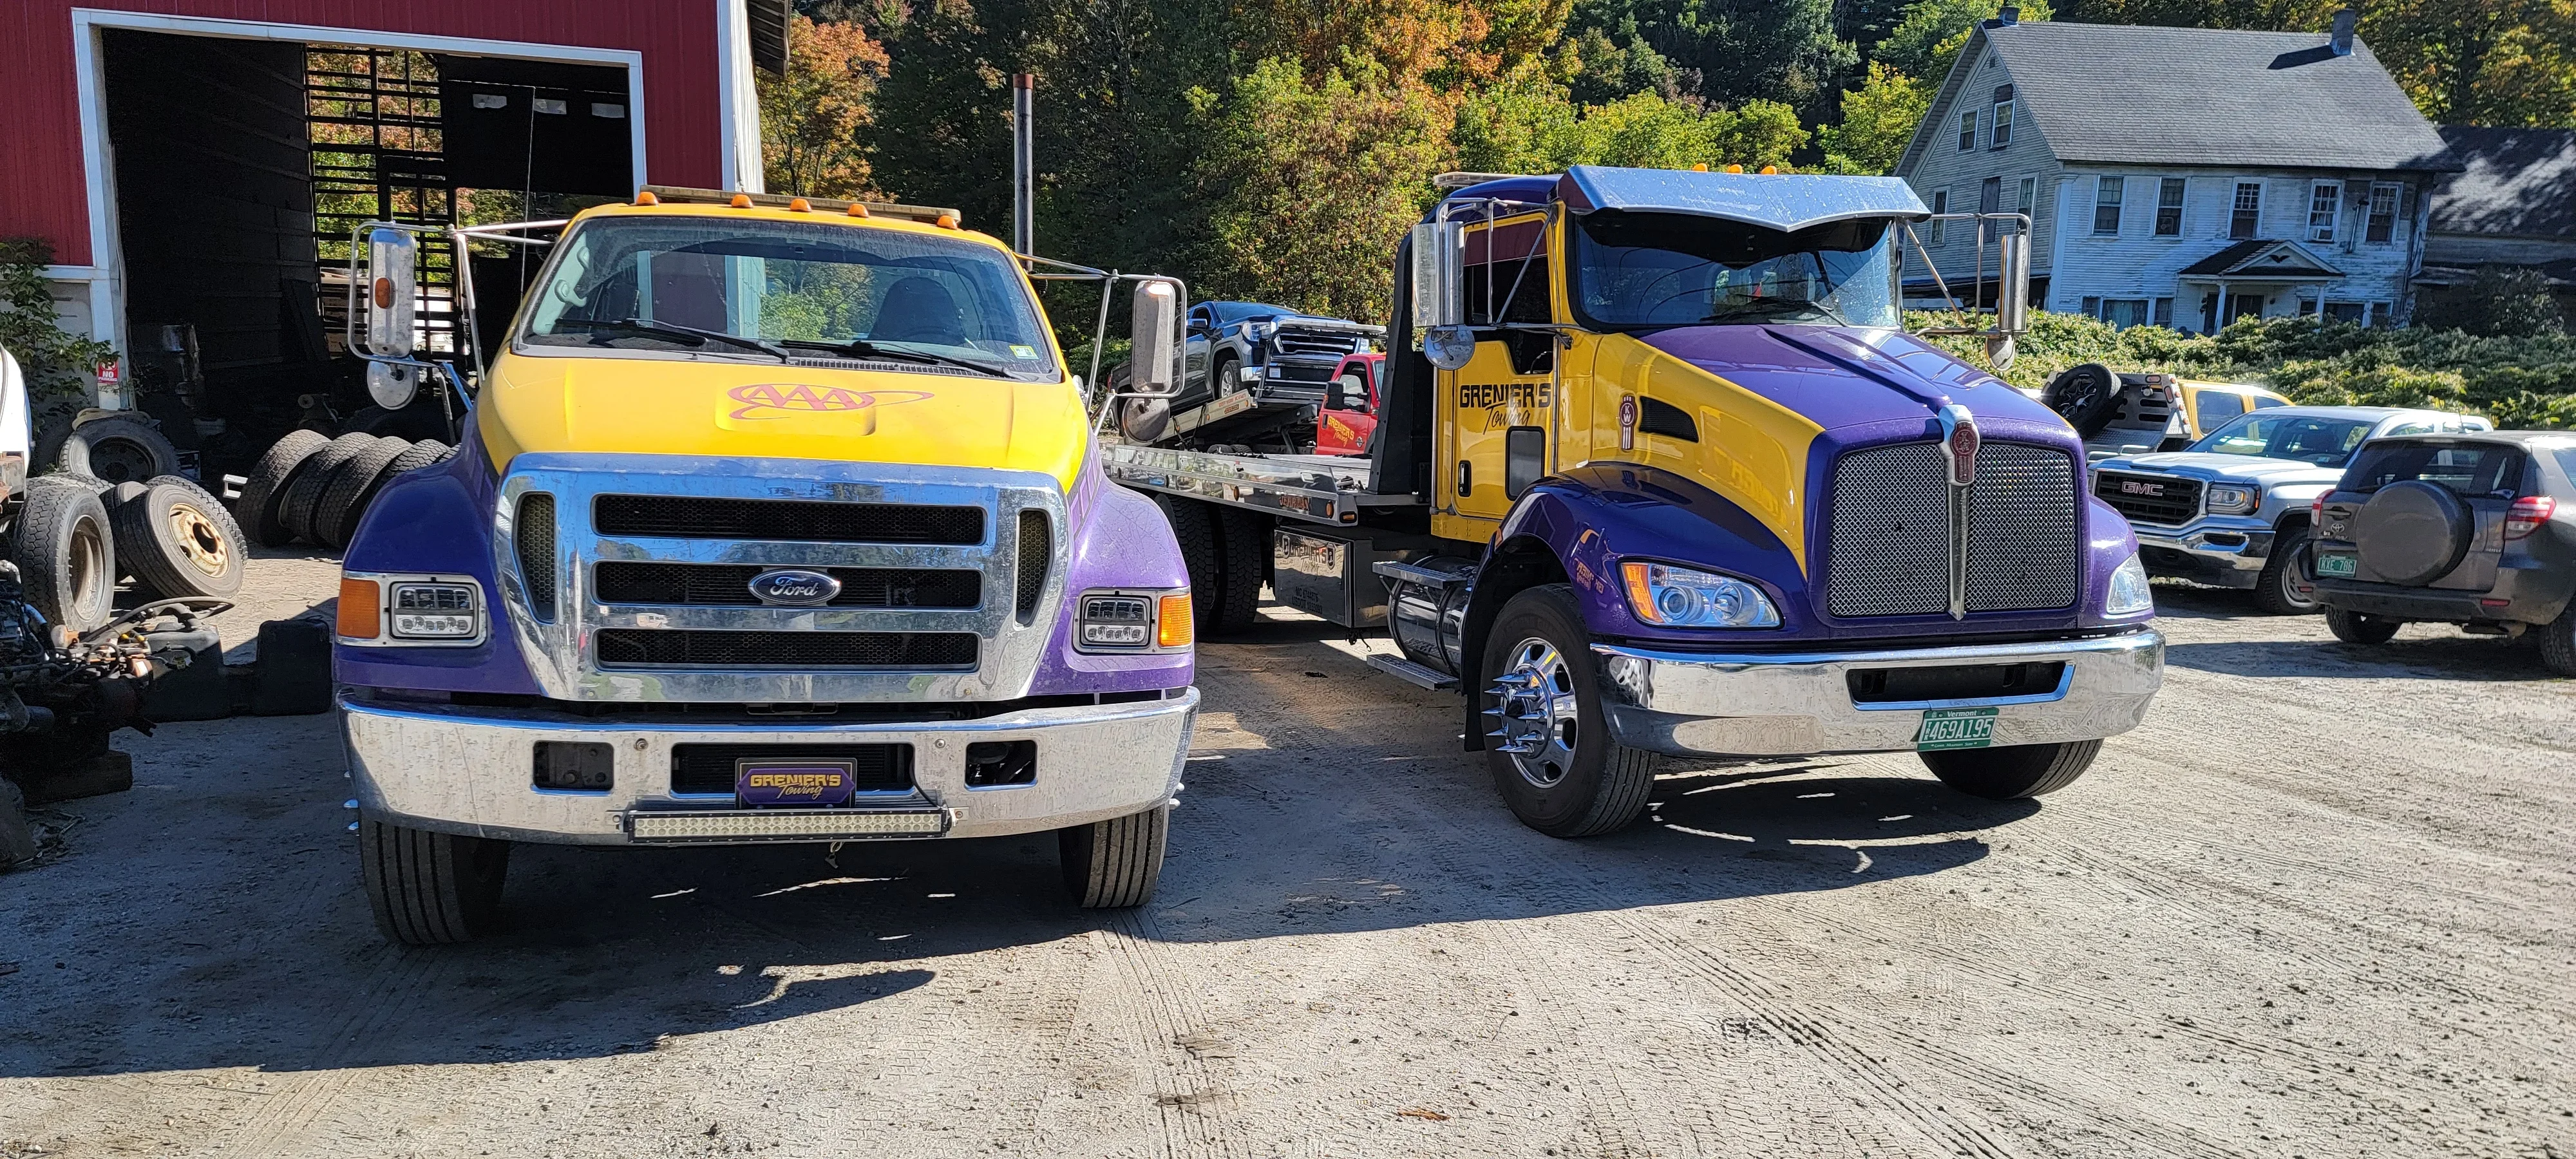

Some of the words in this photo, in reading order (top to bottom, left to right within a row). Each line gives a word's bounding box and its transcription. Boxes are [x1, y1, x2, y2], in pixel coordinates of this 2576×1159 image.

[744, 384, 863, 410] AAA
[1459, 383, 1552, 408] GRENIER'S
[1482, 402, 1531, 435] Towing
[2121, 481, 2164, 496] GMC
[2321, 558, 2336, 570] KXE
[770, 576, 819, 596] Ford
[1924, 722, 1932, 740] TRK
[1929, 718, 1994, 740] 469A195
[750, 775, 841, 787] GRENIER'S
[776, 783, 824, 800] Towing
